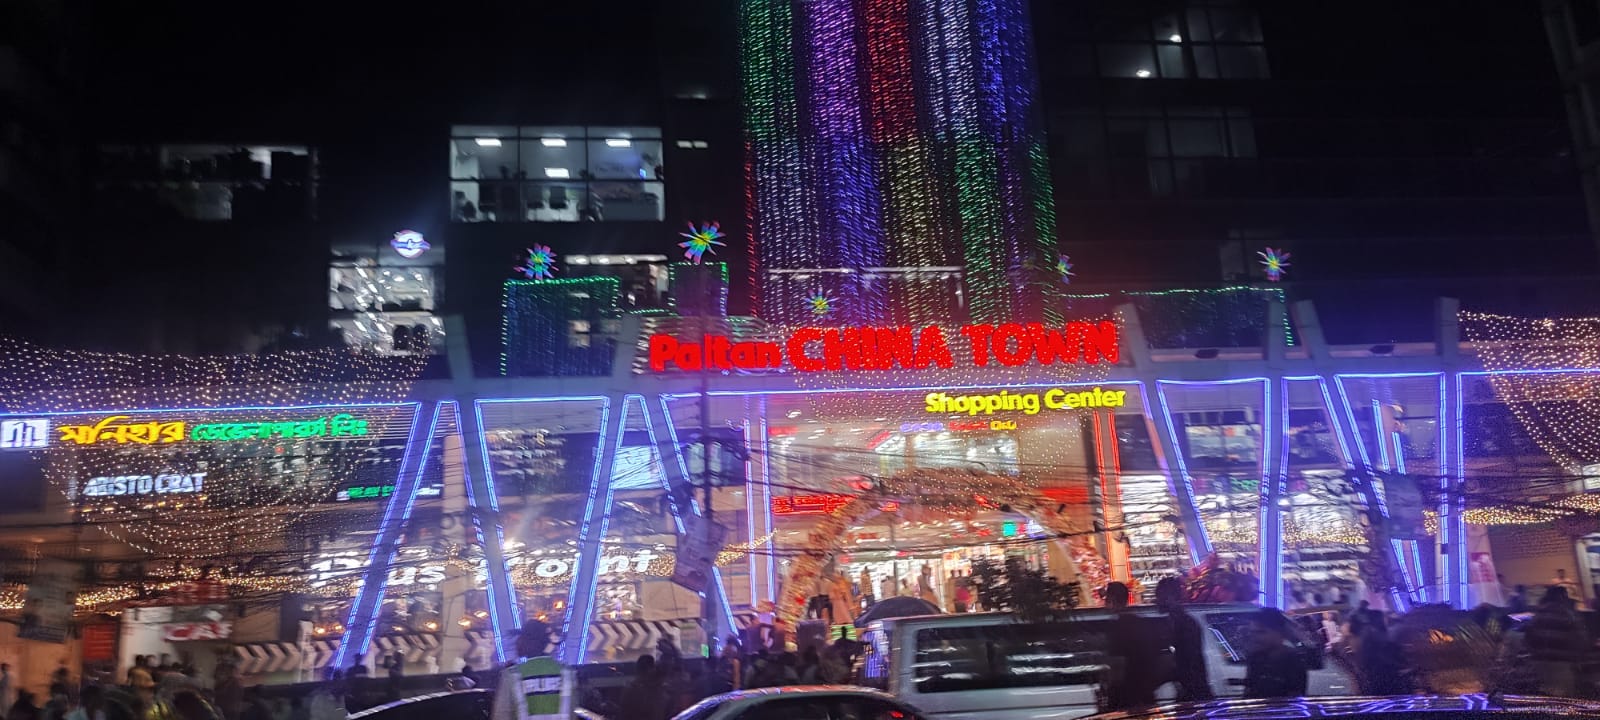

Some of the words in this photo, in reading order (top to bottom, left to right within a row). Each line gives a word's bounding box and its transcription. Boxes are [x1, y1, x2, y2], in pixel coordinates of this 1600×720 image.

[649, 333, 782, 371] Paltan
[786, 325, 954, 371] CHINA
[961, 320, 1120, 367] TOWN
[925, 389, 1041, 416] Shopping
[1043, 387, 1126, 410] Center
[309, 557, 446, 588] Pus
[468, 549, 658, 583] ont
